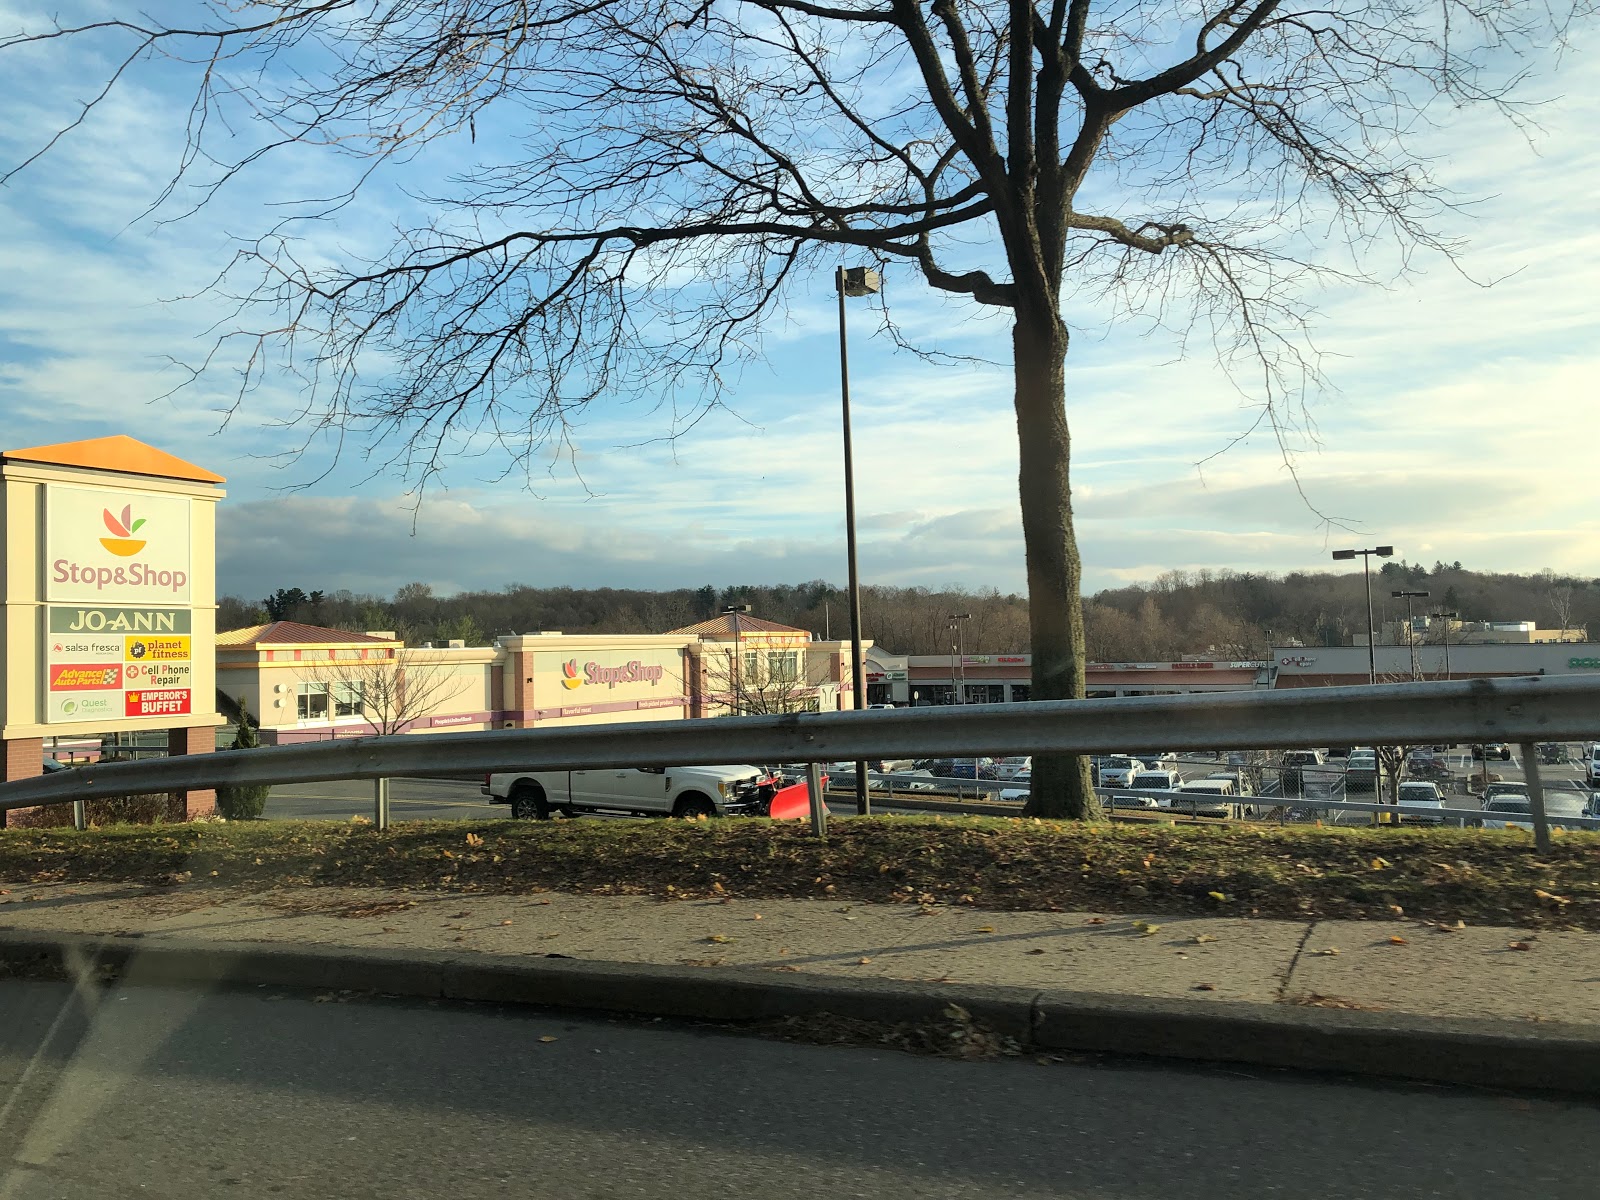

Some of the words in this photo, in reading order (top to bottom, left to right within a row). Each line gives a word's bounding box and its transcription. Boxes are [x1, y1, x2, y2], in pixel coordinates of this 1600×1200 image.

[53, 559, 187, 592] Stop&Shop
[69, 610, 176, 632] JO-ANN
[65, 643, 89, 652] salsa
[91, 643, 120, 652] fresca
[147, 640, 182, 652] planet
[152, 649, 189, 659] fitness
[59, 669, 102, 679] Advance
[141, 664, 159, 675] Cell
[161, 664, 190, 675] Phone
[584, 660, 663, 689] Stop&Shop
[53, 677, 77, 686] Auto
[76, 676, 100, 686] Parts
[150, 675, 181, 687] Repair
[141, 690, 188, 702] EMPEROR'S
[81, 698, 108, 707] Quest
[141, 700, 183, 714] BUFFET
[562, 707, 580, 715] flavorful
